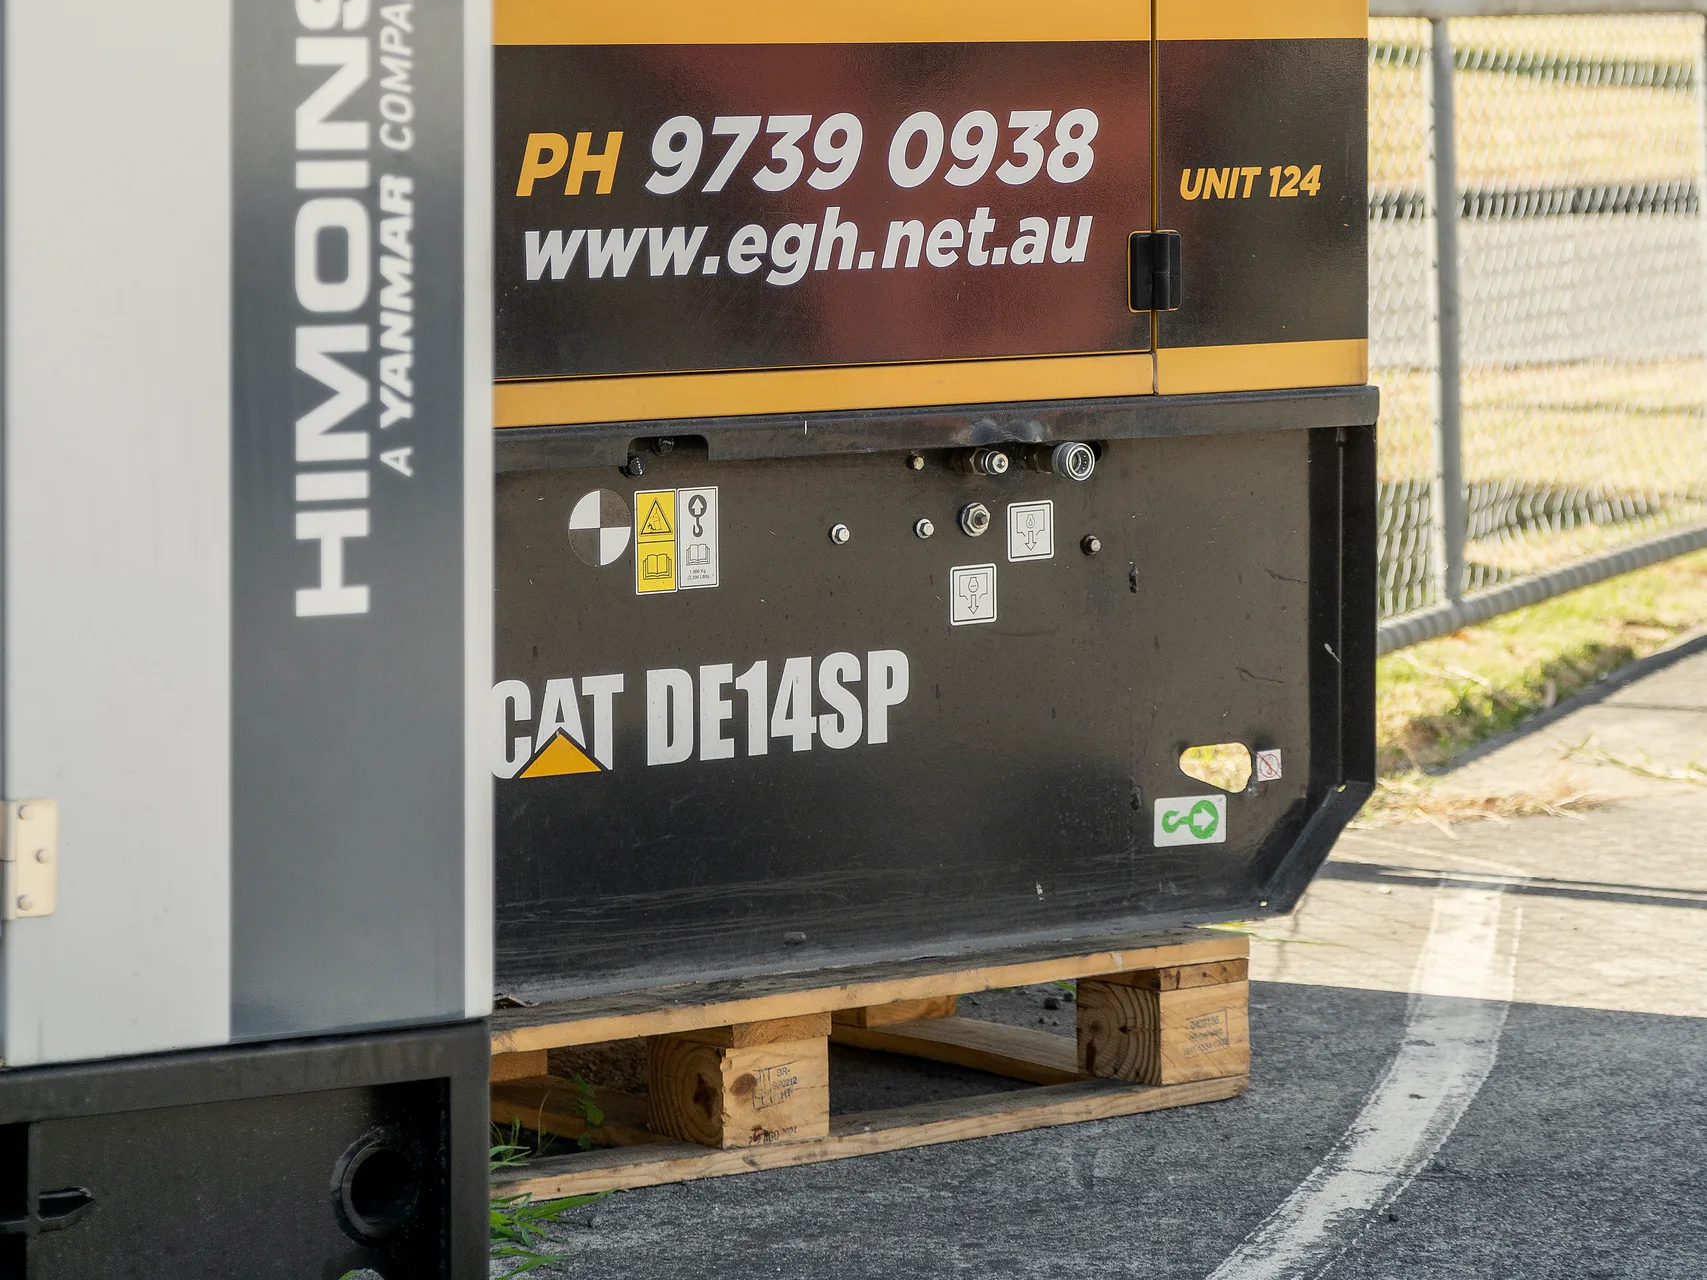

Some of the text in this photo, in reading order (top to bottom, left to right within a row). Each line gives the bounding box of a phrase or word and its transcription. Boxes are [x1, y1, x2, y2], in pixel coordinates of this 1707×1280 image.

[515, 108, 1099, 197] PH 9739 0938
[1179, 164, 1322, 201] UNIT 124
[524, 206, 1093, 286] www.egh.net.au
[379, 173, 414, 429] YANMAR
[379, 446, 414, 478] A
[491, 649, 909, 779] CAT DE14SP
